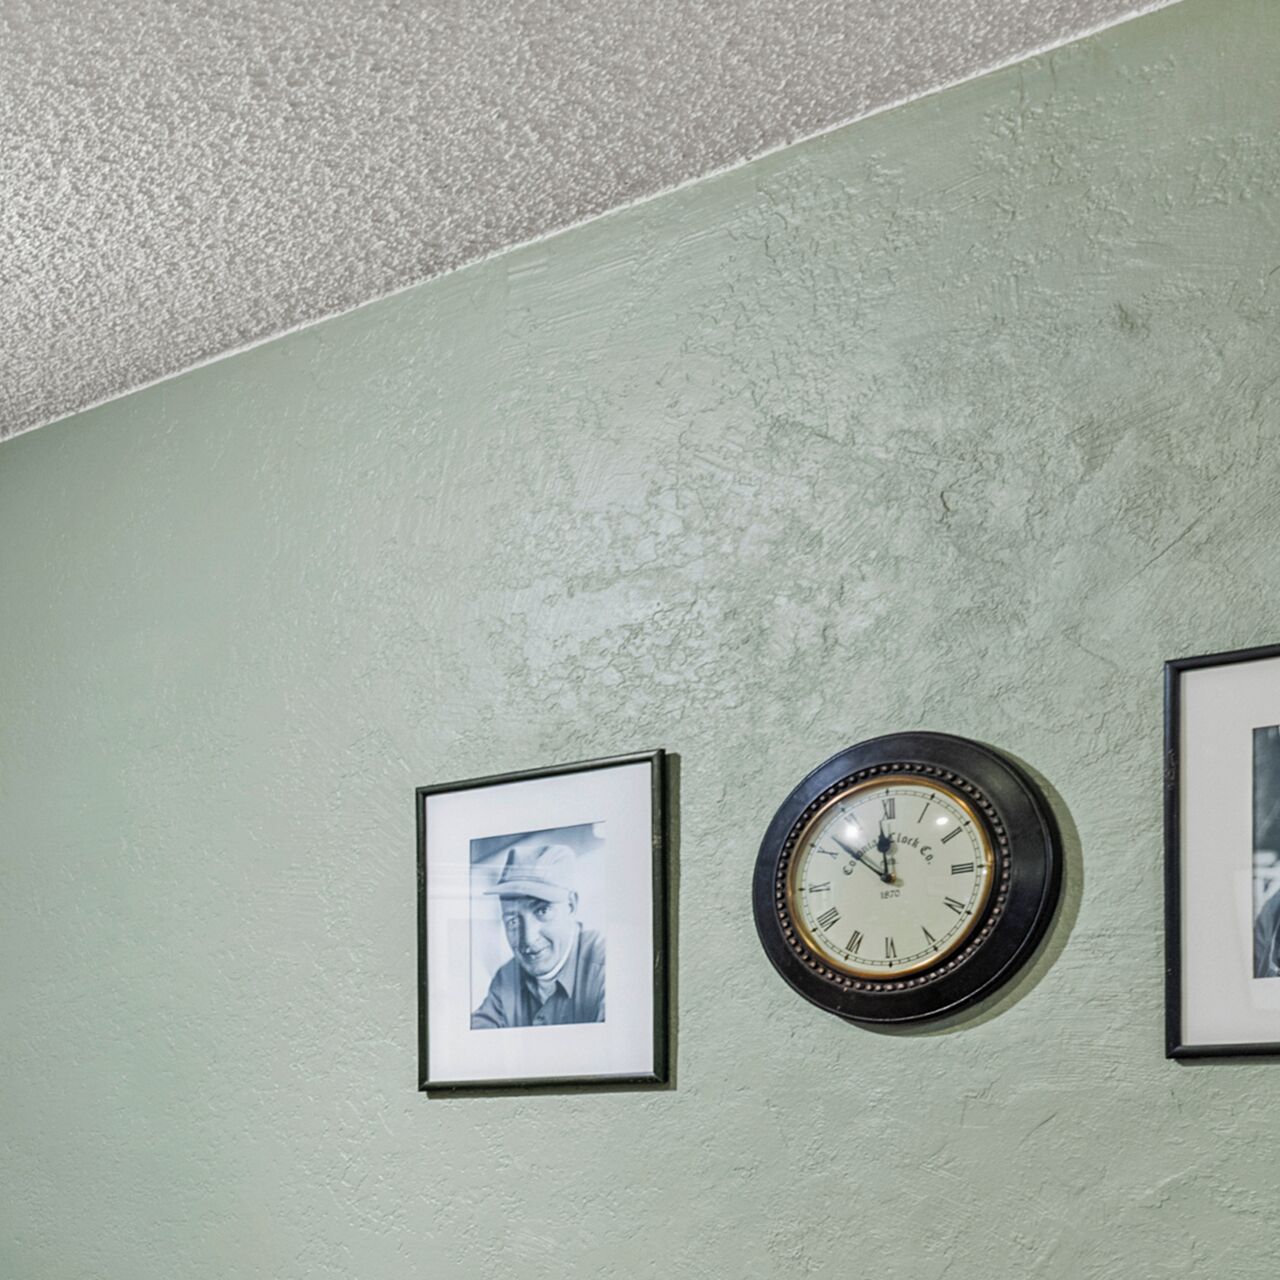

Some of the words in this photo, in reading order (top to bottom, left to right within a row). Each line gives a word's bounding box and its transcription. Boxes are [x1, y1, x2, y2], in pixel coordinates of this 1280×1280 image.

[882, 798, 895, 820] XII
[941, 826, 963, 844] II
[843, 837, 880, 875] Coonia
[951, 862, 974, 875] III
[880, 889, 900, 899] 1870
